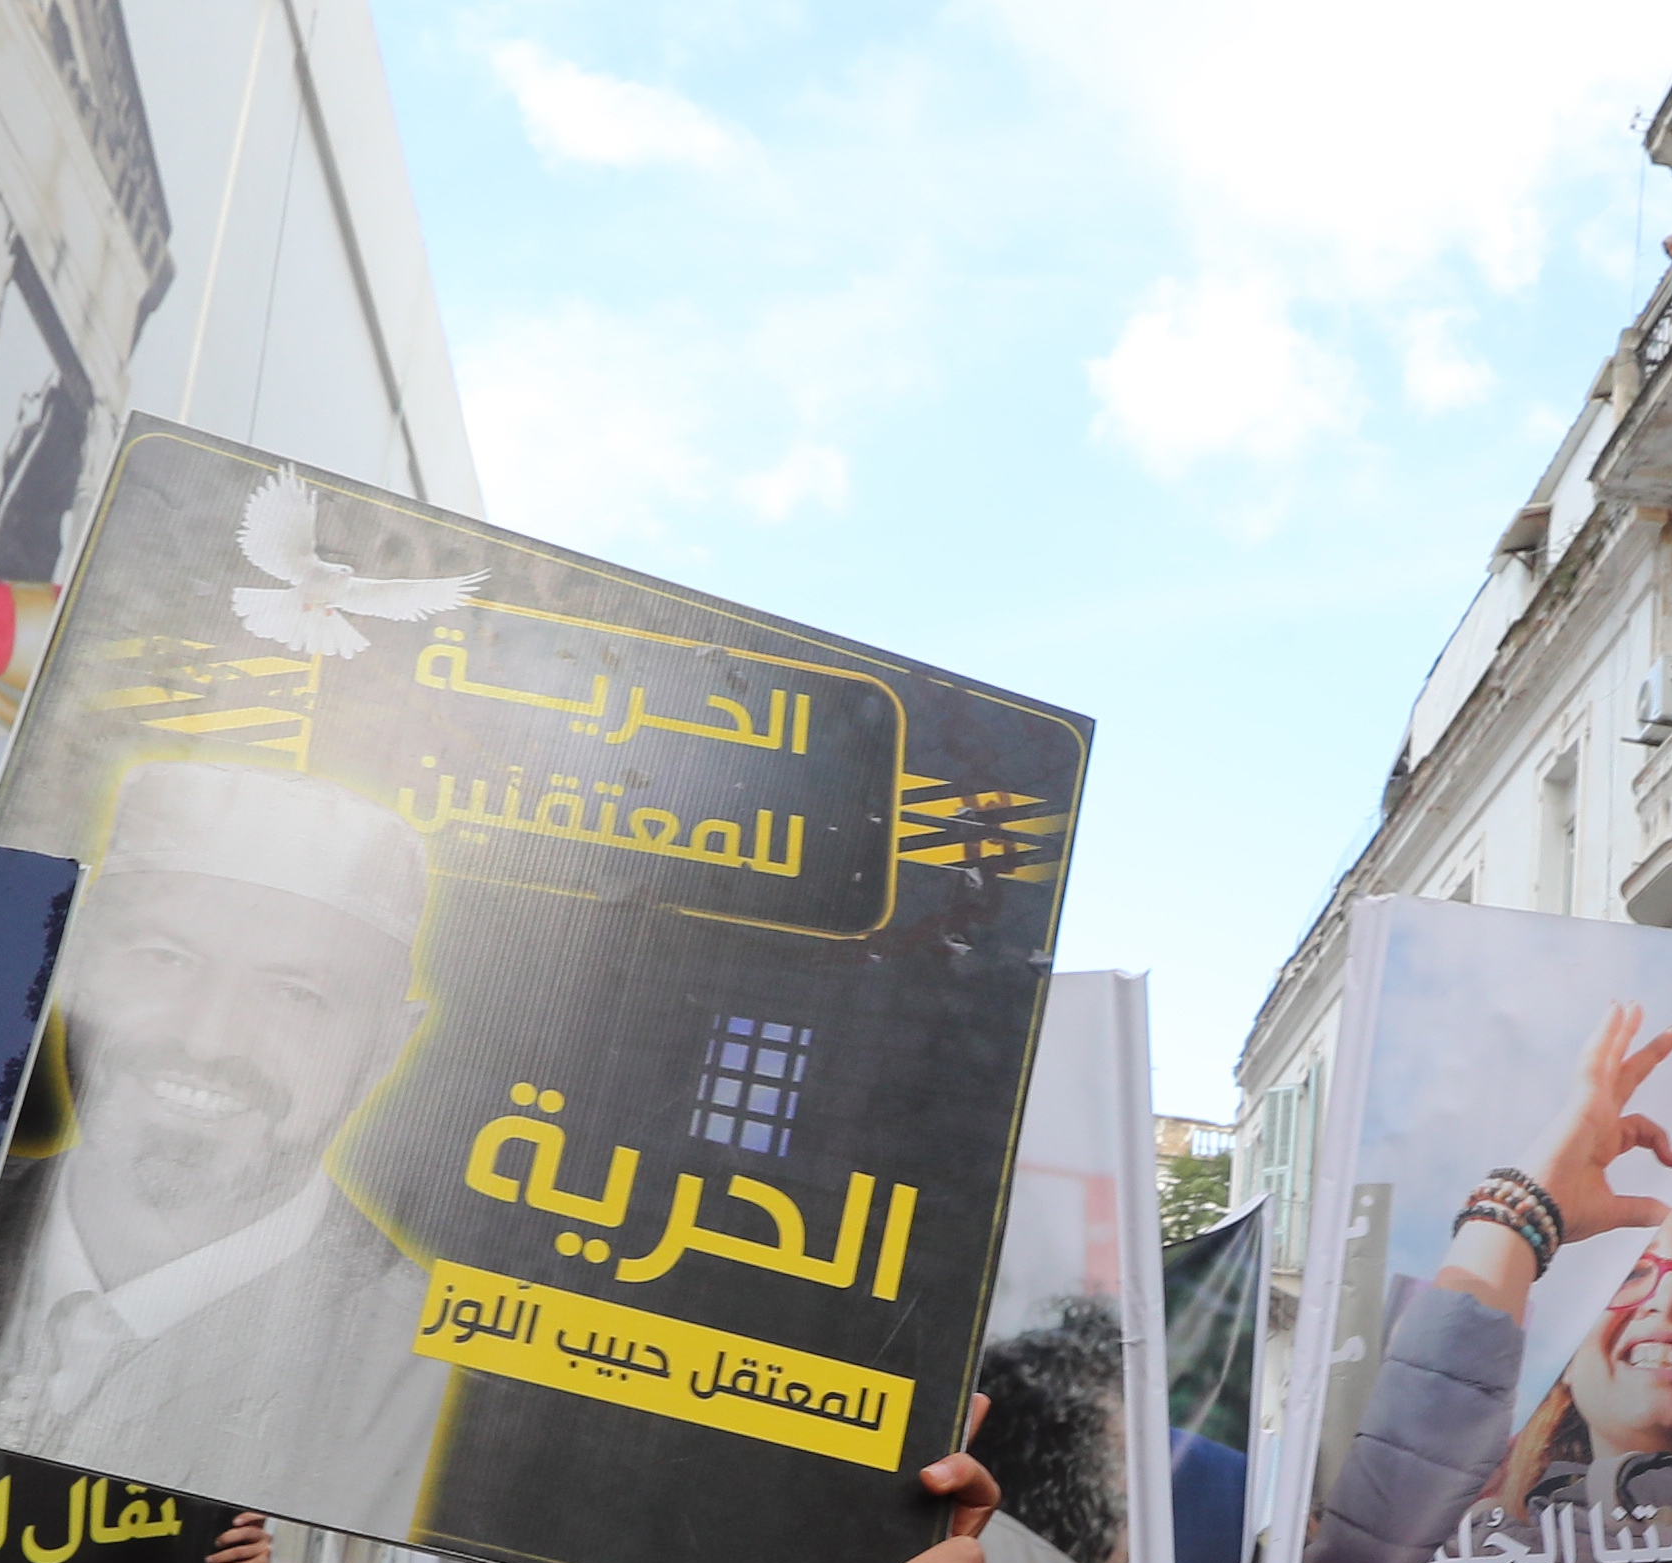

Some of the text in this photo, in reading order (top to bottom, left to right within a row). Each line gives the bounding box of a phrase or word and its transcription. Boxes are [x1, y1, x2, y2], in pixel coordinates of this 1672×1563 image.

[464, 1082, 919, 1302] الحرية
[555, 1327, 671, 1381] حبيب
[689, 1350, 888, 1432] للمعتقل
